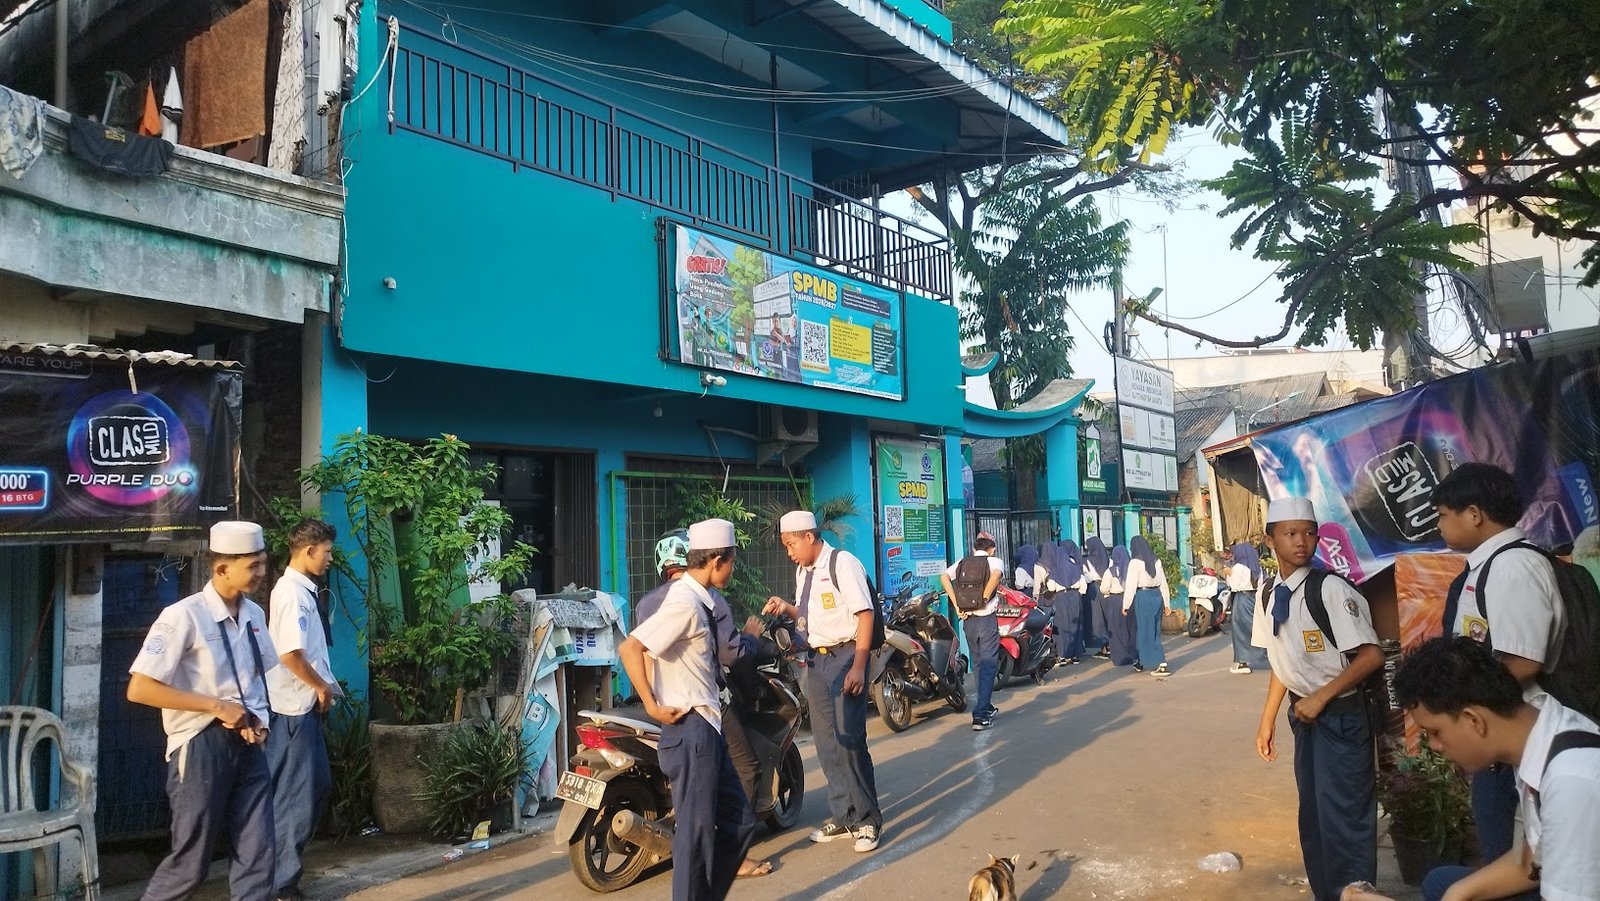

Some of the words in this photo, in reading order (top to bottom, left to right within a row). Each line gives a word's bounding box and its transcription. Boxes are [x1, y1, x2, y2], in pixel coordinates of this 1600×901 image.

[792, 270, 837, 302] SPMB
[40, 358, 83, 370] YOU?
[1130, 367, 1161, 388] YAYASAN
[98, 425, 144, 459] CLAS
[142, 422, 162, 456] MILD
[1374, 451, 1417, 483] MILD
[66, 474, 144, 485] PURPLE
[899, 481, 927, 499] SPMB
[16, 493, 34, 502] BTG
[1575, 478, 1598, 524] New
